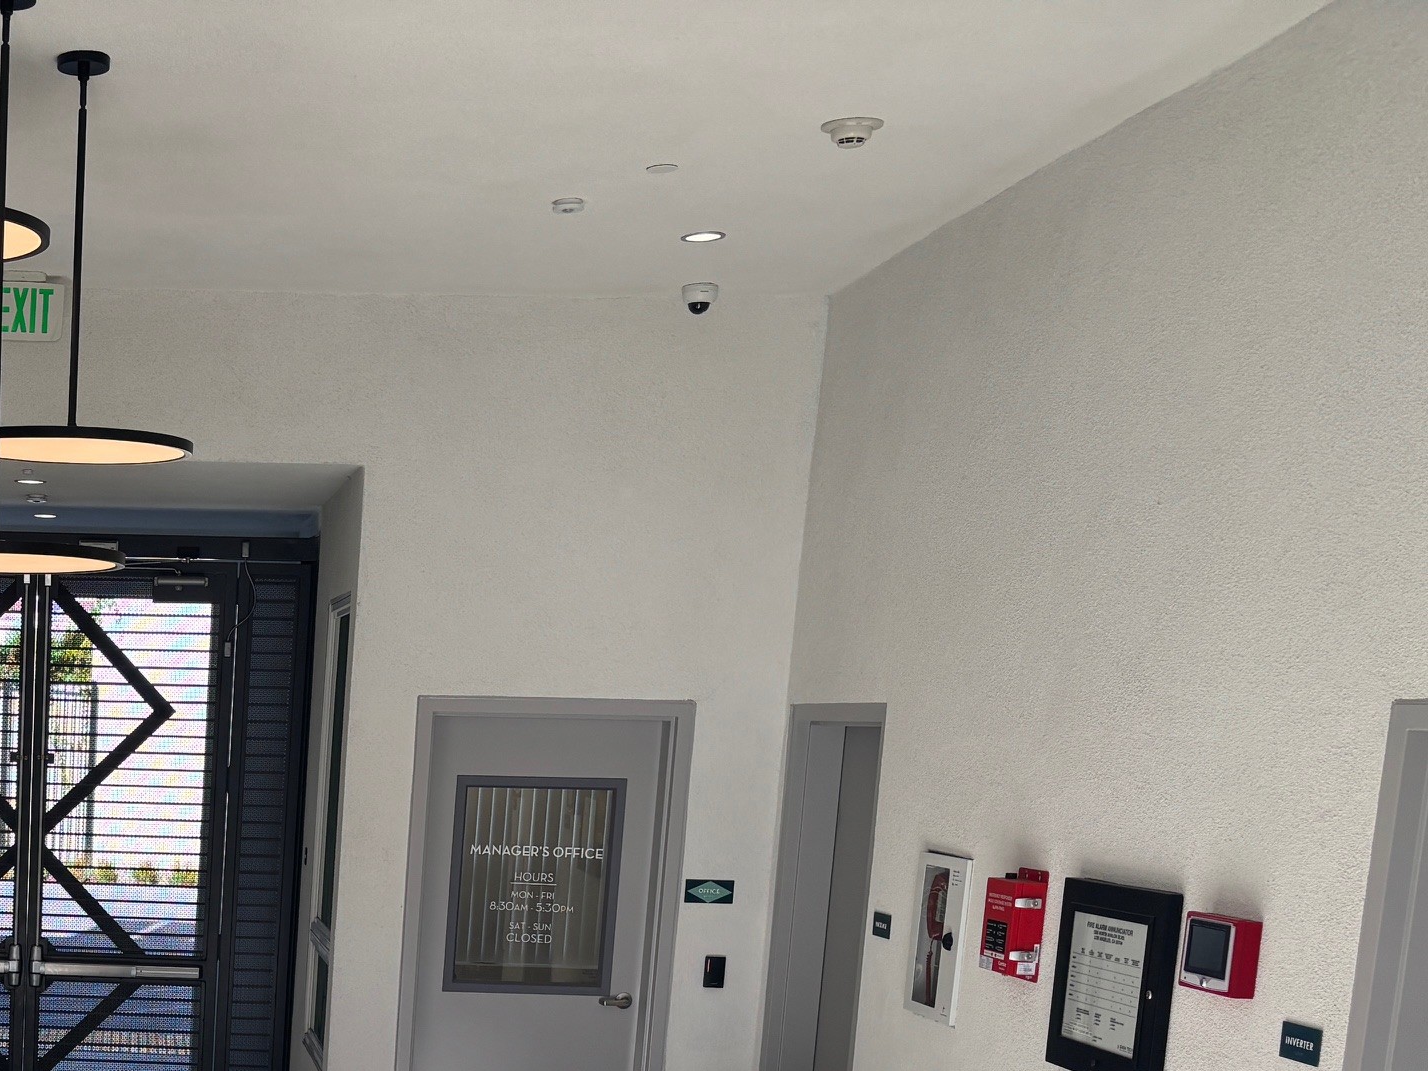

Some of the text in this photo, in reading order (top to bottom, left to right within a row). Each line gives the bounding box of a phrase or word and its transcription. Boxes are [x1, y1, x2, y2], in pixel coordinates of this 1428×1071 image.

[1, 287, 54, 334] EXIT
[470, 844, 604, 860] MANAGER'S OFFICE
[514, 871, 554, 883] HOURS
[511, 890, 534, 900] MON
[541, 891, 556, 901] FRI
[489, 901, 528, 912] 8:30AM
[535, 902, 574, 914] 5:30PM
[509, 921, 526, 930] SAT
[532, 922, 552, 931] SUN
[506, 932, 553, 944] CLOSED
[1285, 1035, 1314, 1051] INVERTER
